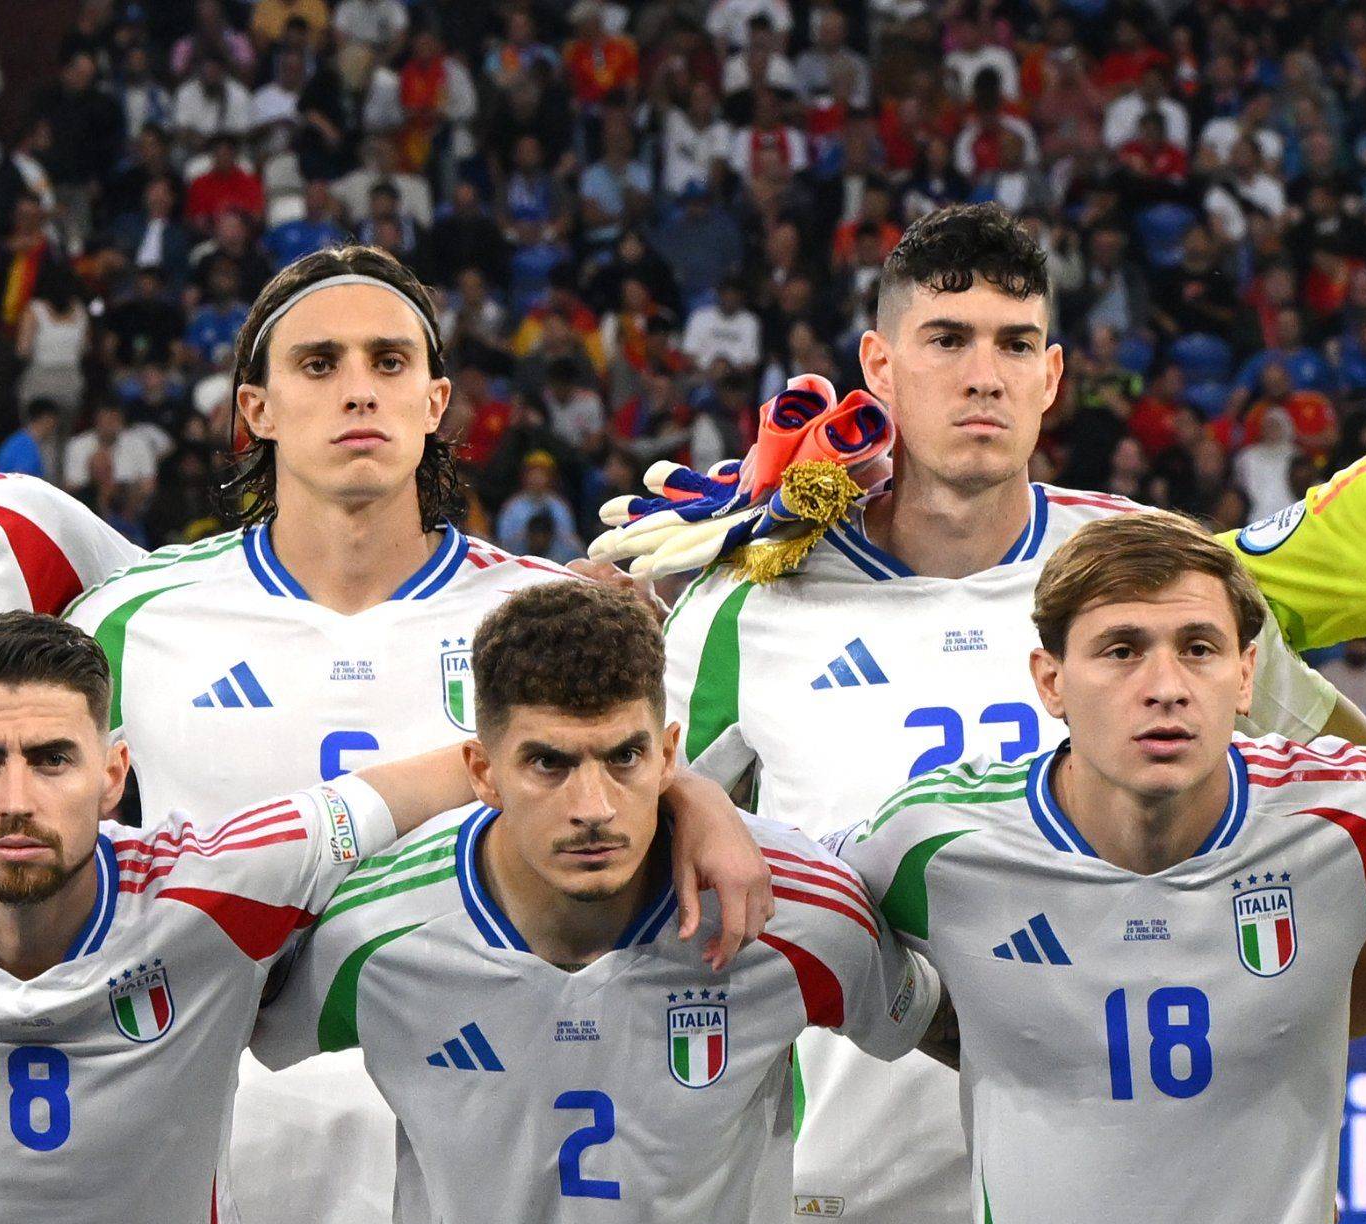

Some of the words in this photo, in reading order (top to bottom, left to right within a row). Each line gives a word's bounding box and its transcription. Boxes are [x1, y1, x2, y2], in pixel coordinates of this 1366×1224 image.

[1238, 893, 1288, 916] ITALIA
[672, 1011, 722, 1028] ITALIA
[1105, 986, 1212, 1100] 18
[8, 1046, 70, 1152] 8
[553, 1090, 620, 1199] 2
